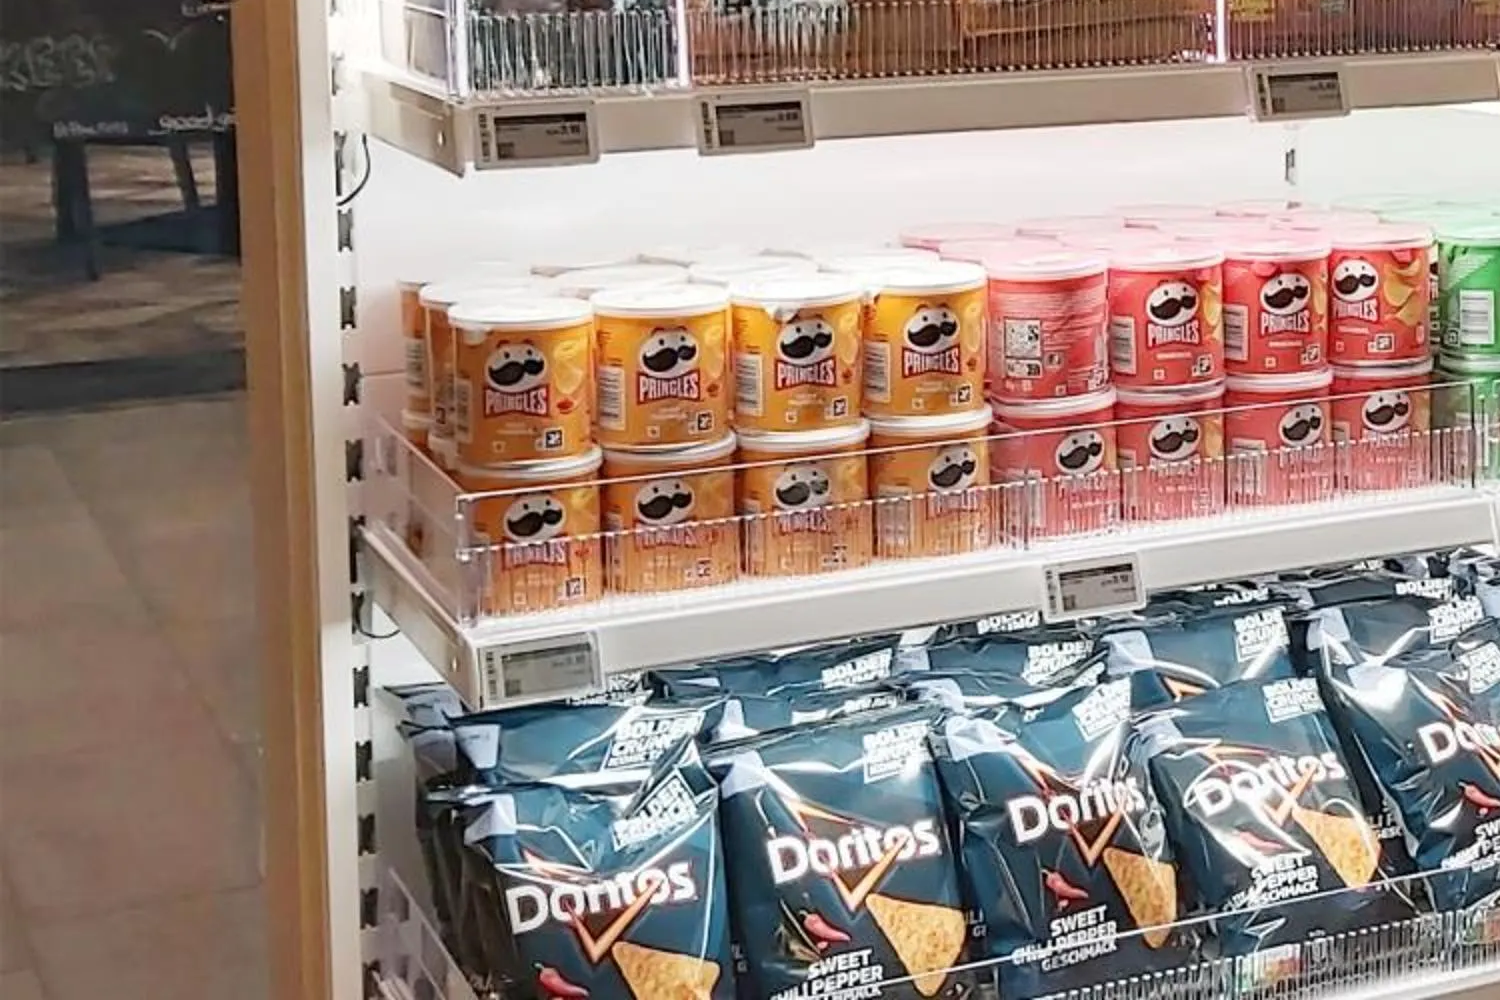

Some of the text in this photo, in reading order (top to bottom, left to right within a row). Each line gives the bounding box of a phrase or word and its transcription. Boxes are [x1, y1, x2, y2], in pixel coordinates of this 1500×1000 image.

[1147, 320, 1200, 347] PRINGLES
[776, 359, 836, 389] PRINGLES
[903, 348, 961, 378] PRINGLES
[483, 387, 548, 416] PRINGLES
[638, 371, 700, 403] PRINGLES
[1028, 640, 1094, 658] BOLDER
[1007, 776, 1147, 844] Doritos
[766, 818, 942, 885] Doritos
[508, 861, 698, 935] Doritos
[1051, 905, 1108, 937] SWEET
[807, 949, 873, 981] SWEET
[1041, 941, 1118, 972] GESCHMACK
[811, 965, 884, 996] PEPPER
